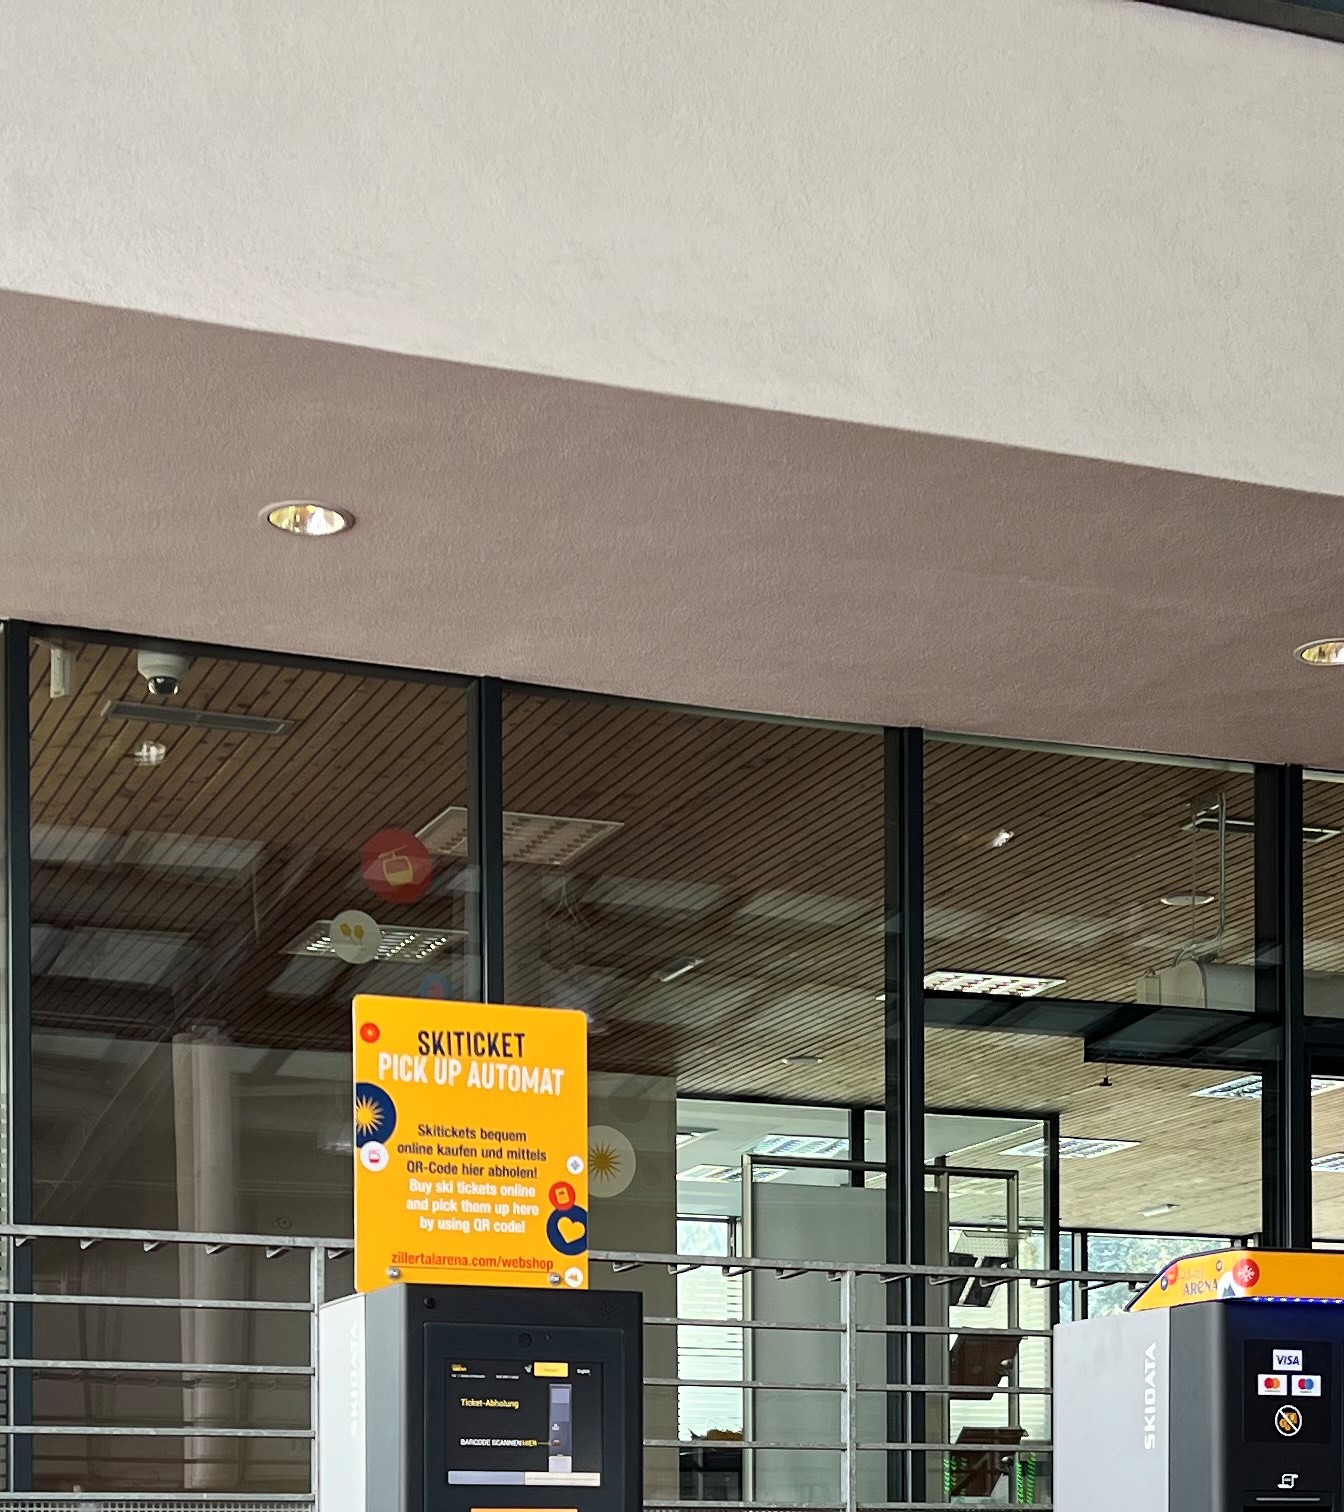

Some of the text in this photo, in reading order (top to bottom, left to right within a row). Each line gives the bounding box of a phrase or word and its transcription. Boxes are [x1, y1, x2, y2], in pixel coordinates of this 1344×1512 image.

[417, 1030, 526, 1058] SKITICKET
[377, 1052, 565, 1096] PICK UP AUTOMAT
[417, 1123, 527, 1143] Skitickets bequem
[397, 1142, 547, 1162] online kaufen und mittels
[406, 1161, 538, 1179] QR-Code hier abholen!
[409, 1178, 536, 1198] Buy ski tickets online
[406, 1198, 539, 1217] and pick them up here
[419, 1215, 526, 1234] by using QR code!
[391, 1251, 554, 1273] zillertalarena.com/webshop
[1275, 1354, 1300, 1366] VISA
[1144, 1341, 1157, 1450] SKIDATA
